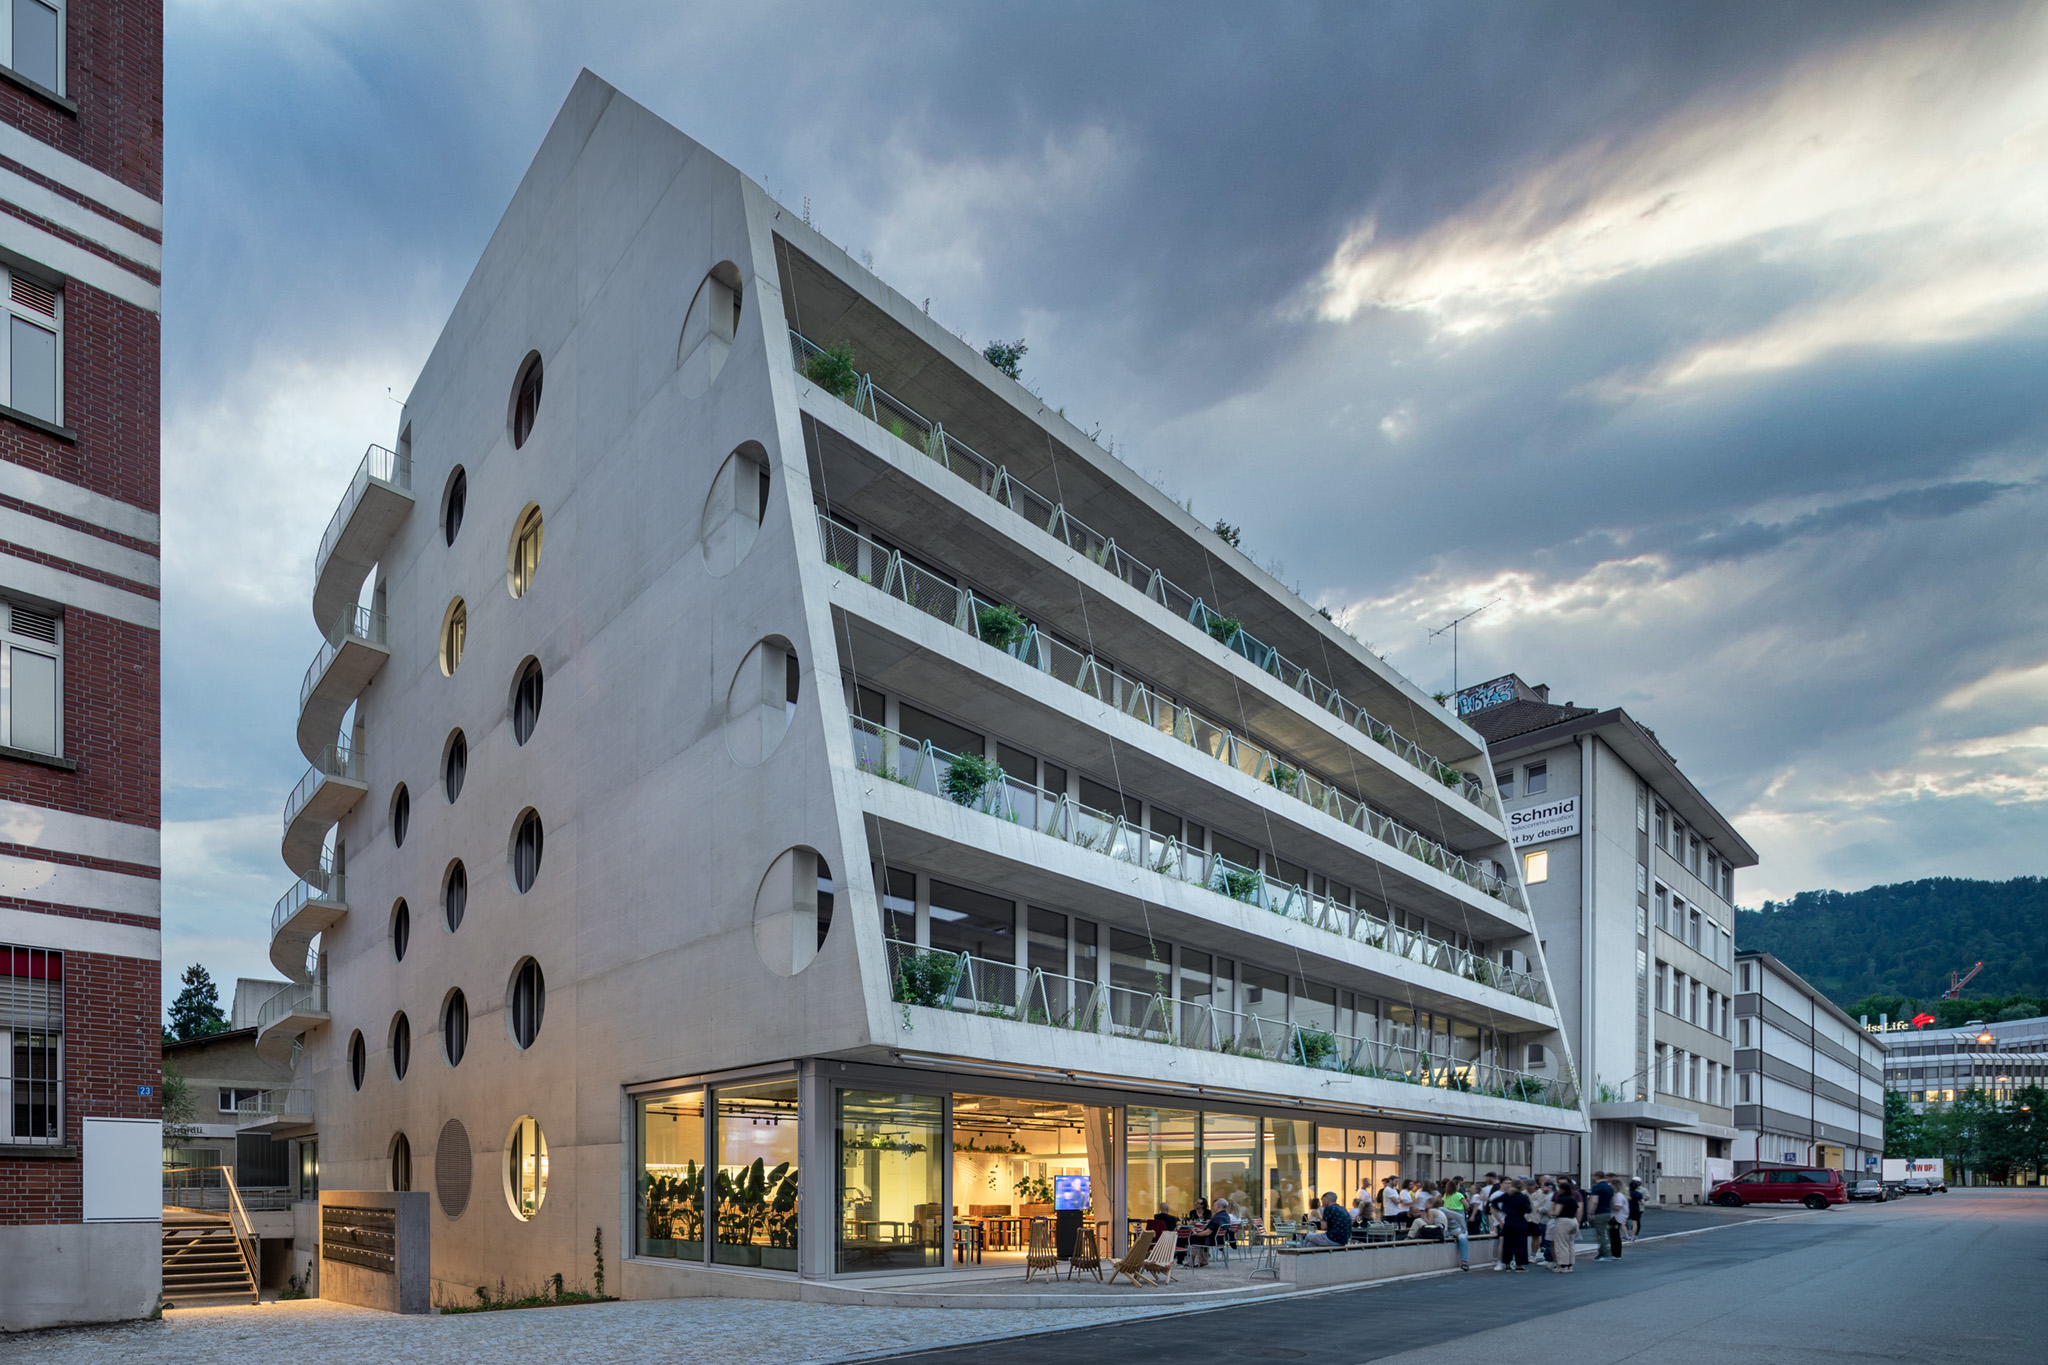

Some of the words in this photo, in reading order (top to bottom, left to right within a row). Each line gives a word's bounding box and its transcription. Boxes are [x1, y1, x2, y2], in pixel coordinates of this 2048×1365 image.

[1511, 800, 1574, 825] Schmid
[1511, 813, 1574, 832] Telecommunication
[1522, 833, 1535, 842] by
[1537, 825, 1574, 838] design
[1884, 1020, 1909, 1031] Life
[140, 1086, 151, 1095] 23
[1357, 1135, 1366, 1148] 29
[1924, 1163, 1933, 1171] UP
